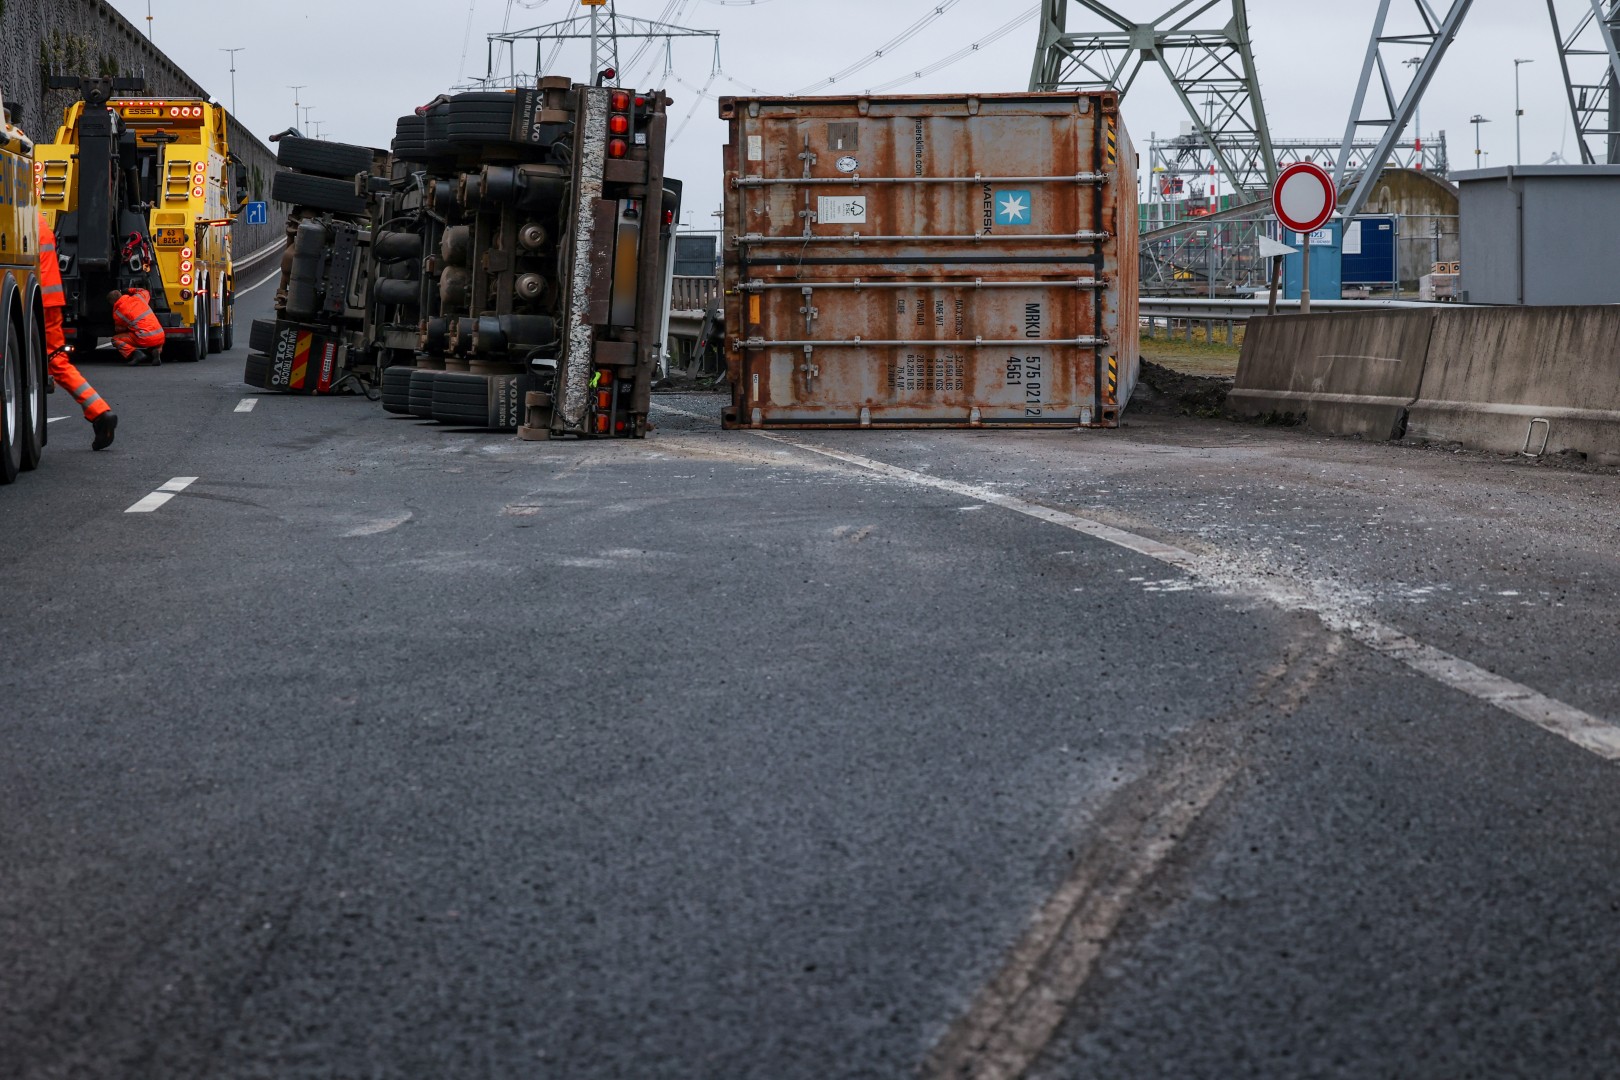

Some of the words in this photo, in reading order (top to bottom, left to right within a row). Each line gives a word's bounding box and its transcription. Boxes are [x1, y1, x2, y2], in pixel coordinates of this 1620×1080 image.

[532, 92, 544, 142] VOVO
[916, 118, 924, 176] maerskline.com
[984, 182, 992, 235] MAERSK
[1026, 304, 1040, 338] MRKU
[288, 330, 298, 344] VAN
[272, 328, 290, 385] VOLVO
[285, 344, 295, 358] DIJK
[280, 360, 292, 384] TRUCKS
[1006, 356, 1021, 385] 45G1
[1026, 356, 1040, 378] 575
[956, 378, 964, 391] KGS
[1026, 383, 1040, 403] 021
